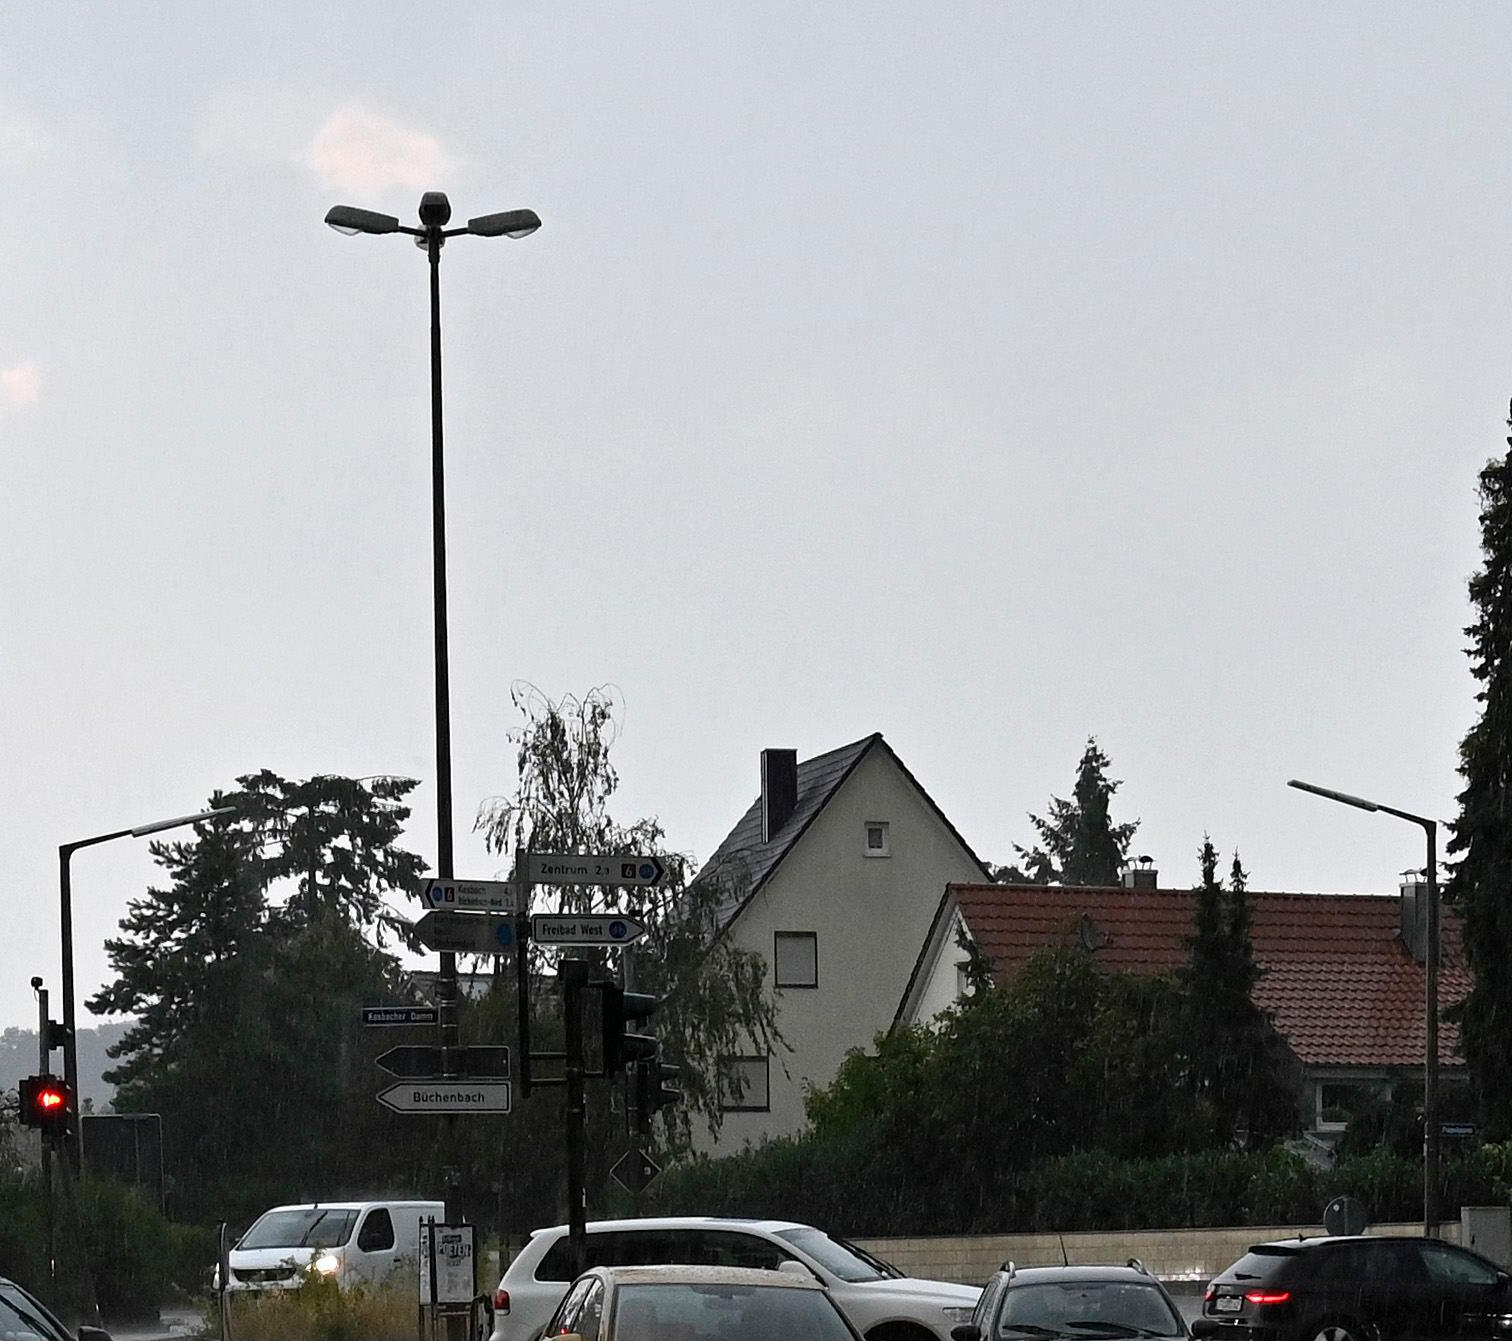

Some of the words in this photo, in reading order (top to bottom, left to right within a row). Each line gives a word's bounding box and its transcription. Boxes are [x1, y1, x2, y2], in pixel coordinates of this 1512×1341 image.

[540, 862, 588, 875] Zentrum
[542, 924, 576, 936] Freibad
[580, 924, 603, 936] West
[413, 1092, 486, 1104] Büchenbach
